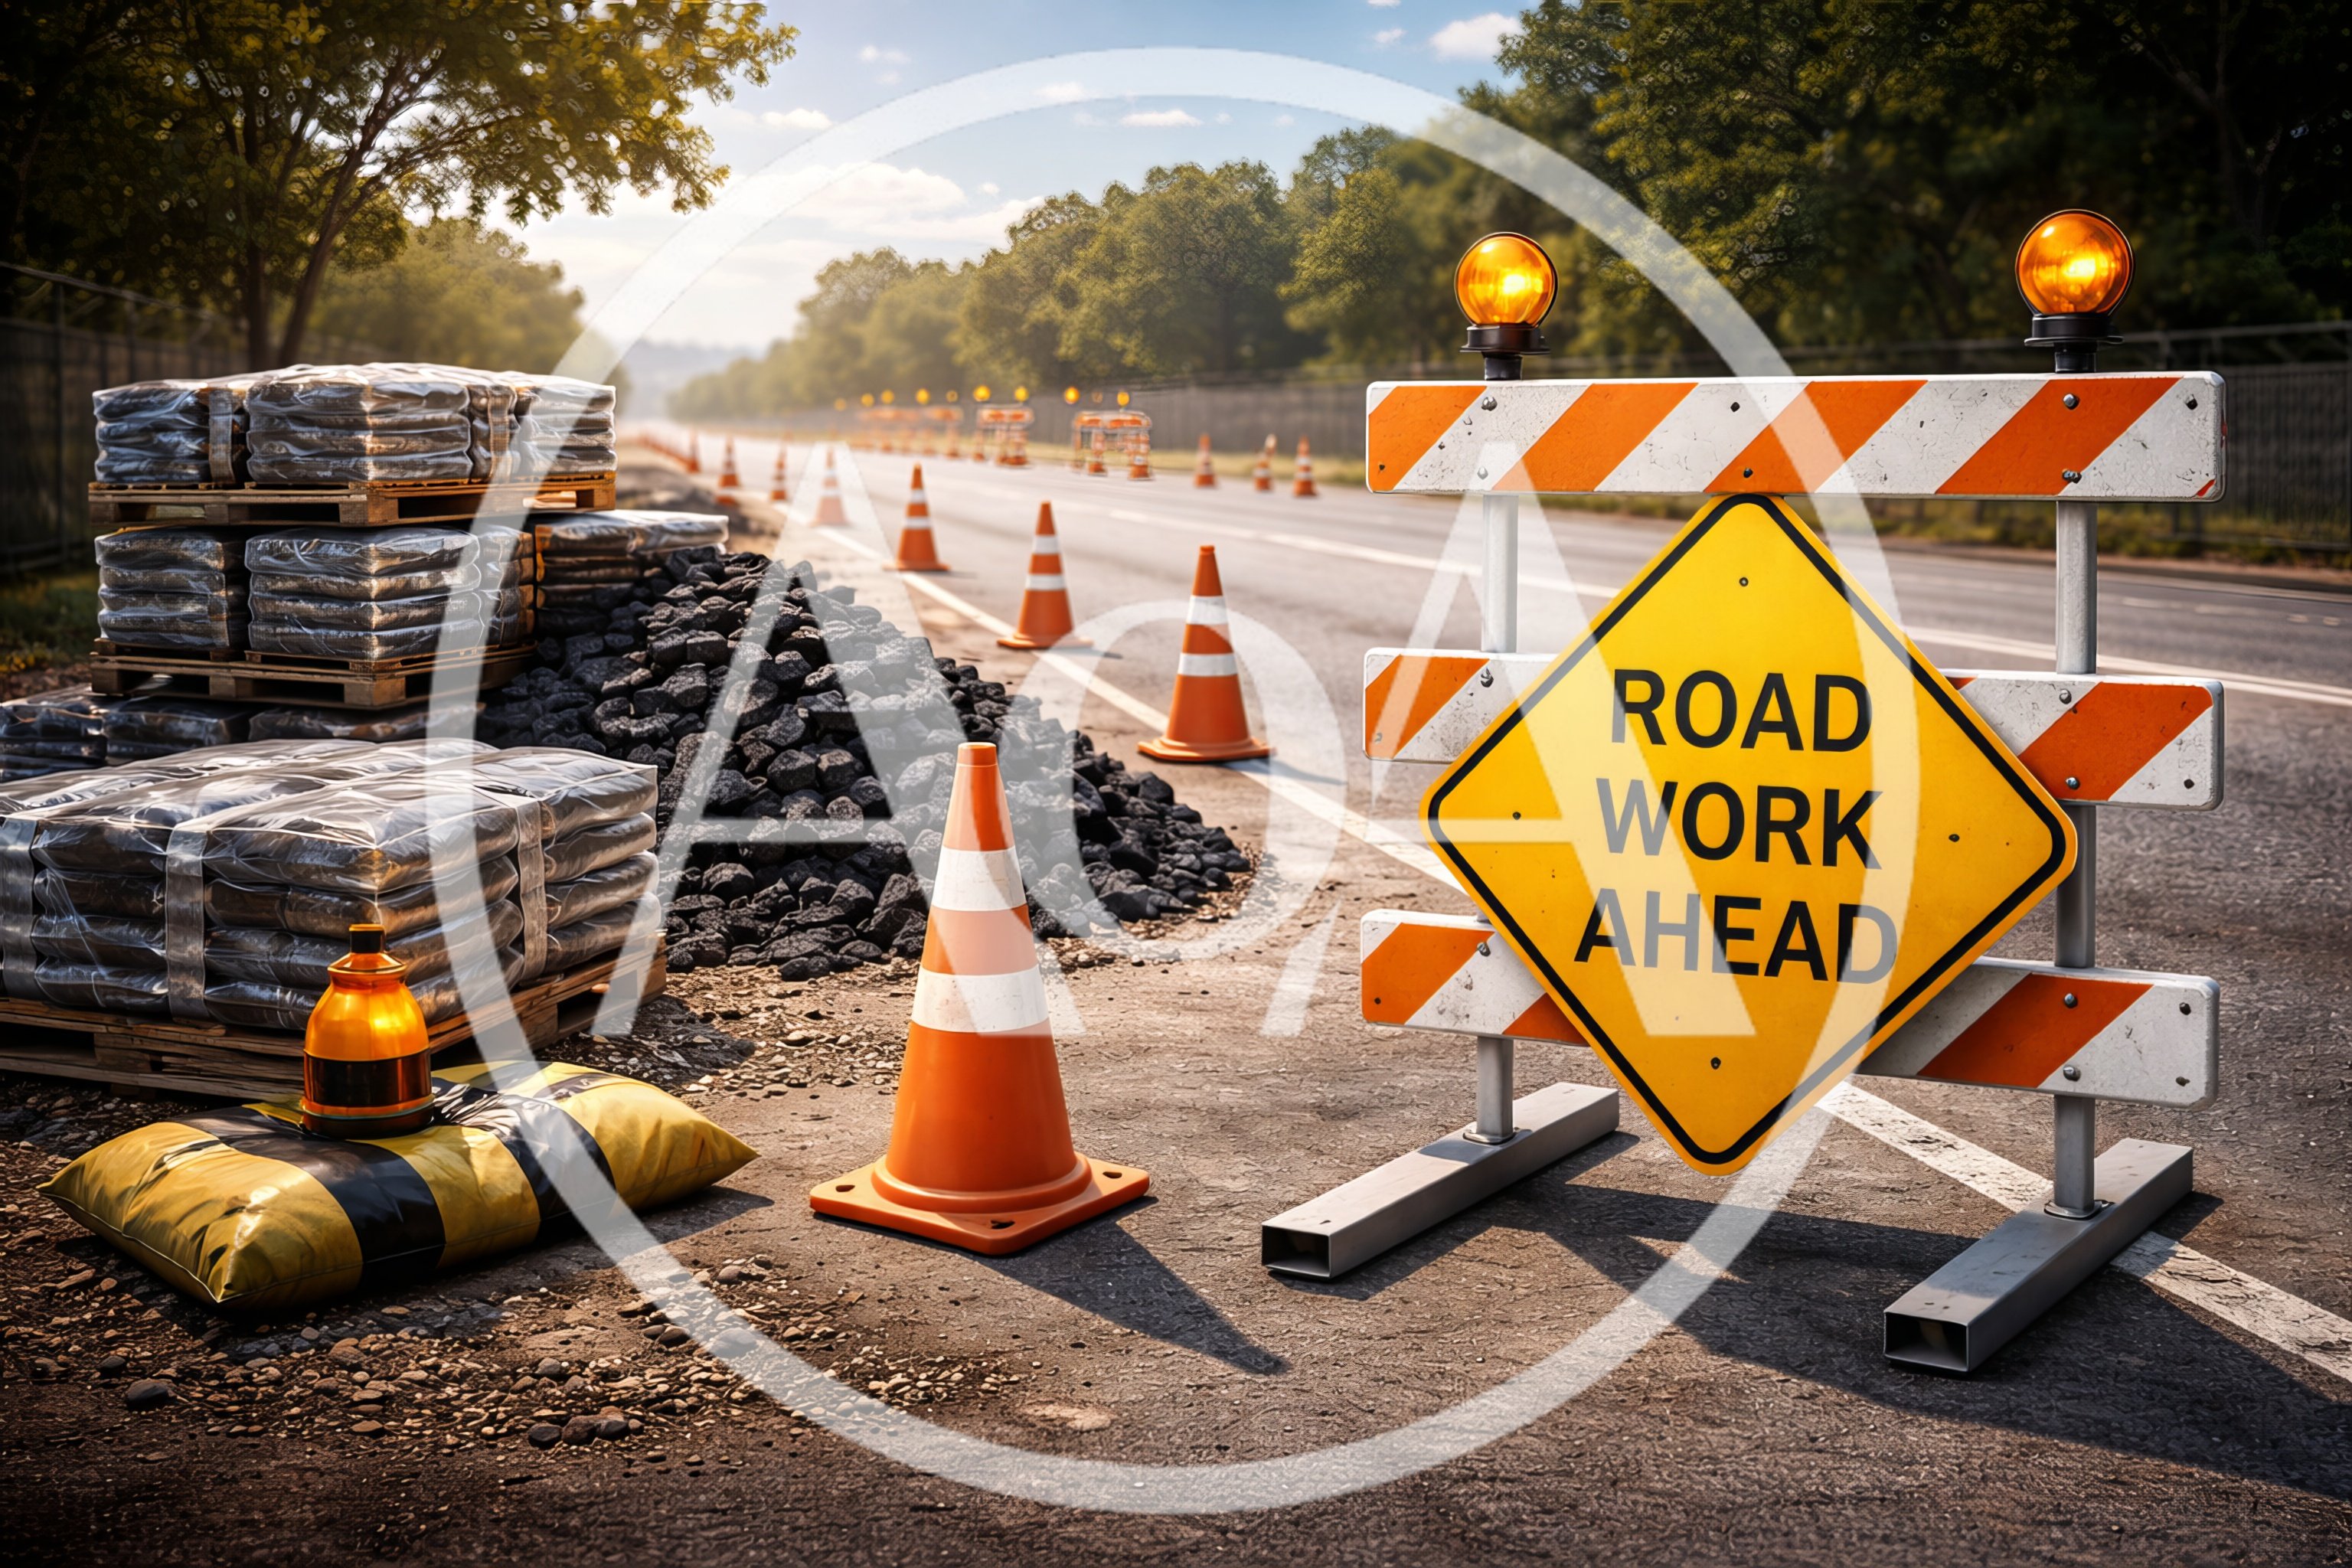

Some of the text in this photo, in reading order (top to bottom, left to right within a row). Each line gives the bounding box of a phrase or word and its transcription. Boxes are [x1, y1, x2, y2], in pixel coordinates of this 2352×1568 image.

[1612, 668, 1873, 753] ROAD
[1596, 777, 1884, 871] WORK
[1573, 887, 1898, 985] AHEAD
